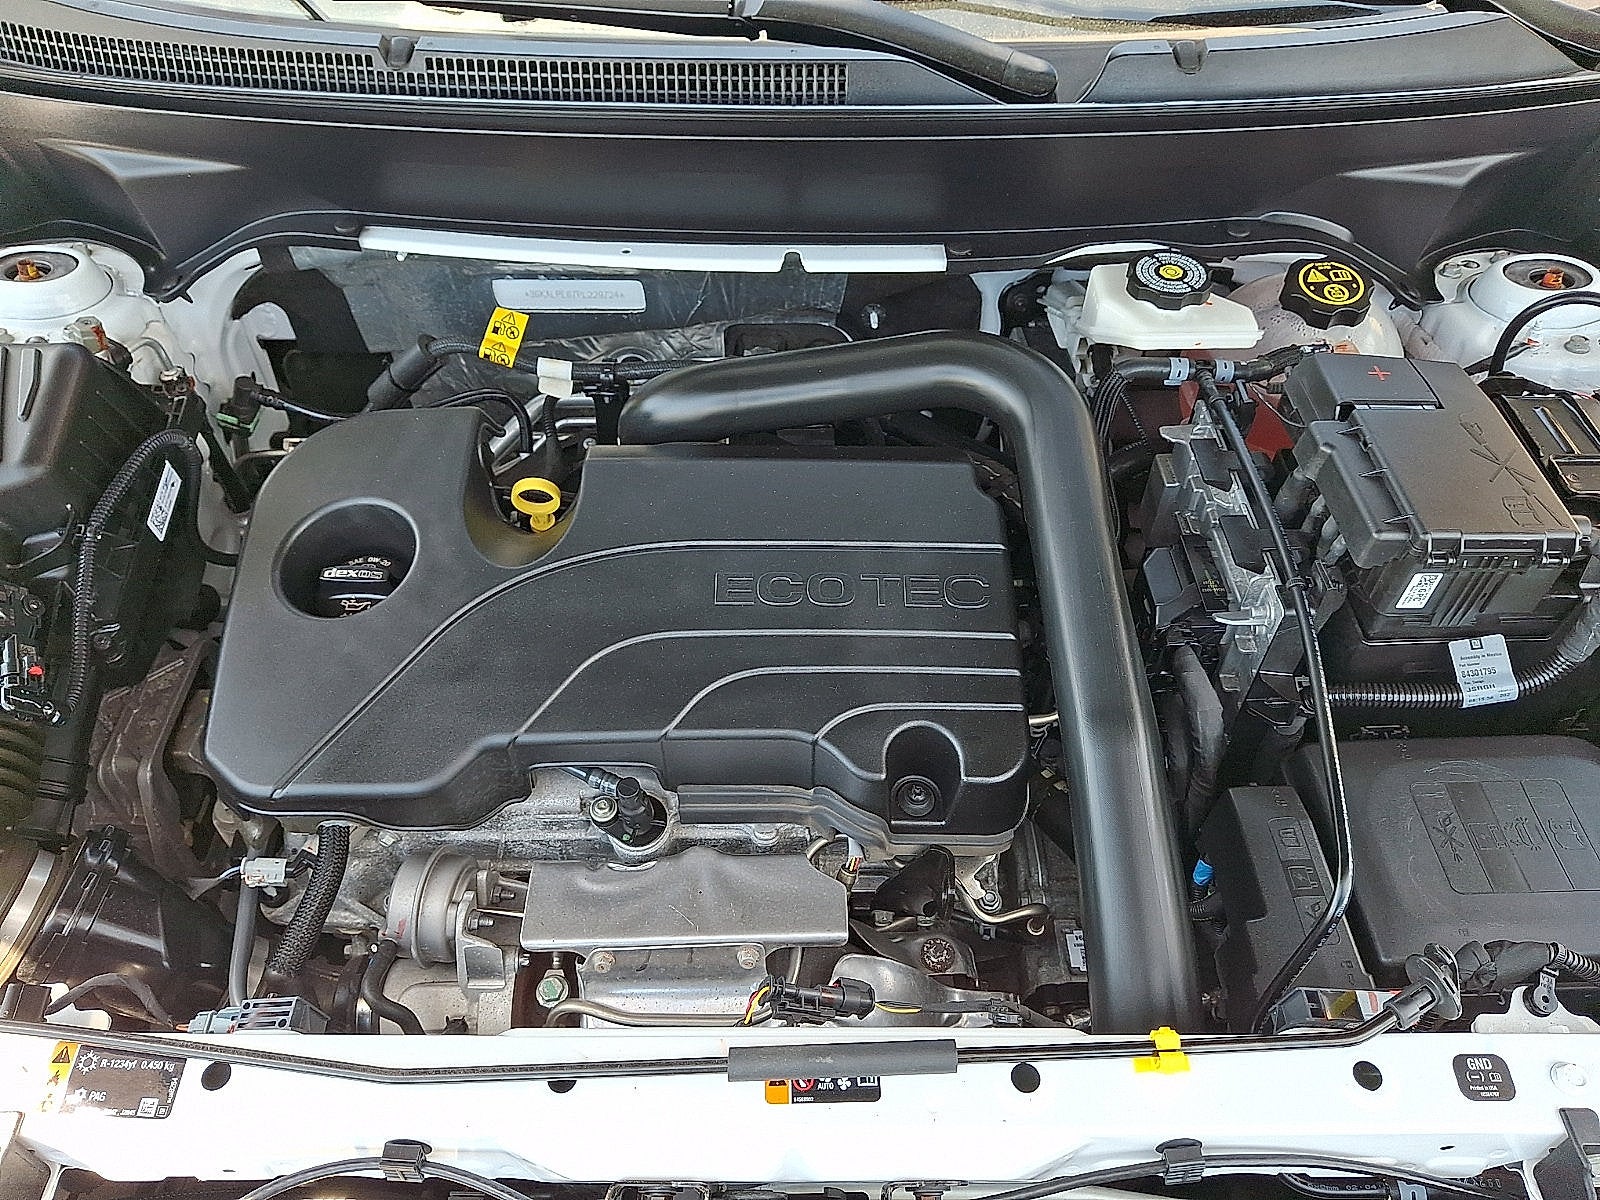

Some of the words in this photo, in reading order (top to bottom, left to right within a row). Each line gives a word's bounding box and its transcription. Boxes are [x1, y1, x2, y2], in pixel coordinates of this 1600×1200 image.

[367, 556, 392, 567] 0W-20
[323, 567, 384, 580] dexos
[714, 571, 991, 610] ECOTEC
[1461, 667, 1497, 678] 84301795
[100, 1058, 137, 1071] R-1234yf
[140, 1059, 164, 1070] 0.450
[164, 1060, 176, 1072] kg
[1466, 1057, 1493, 1070] GND
[817, 1082, 834, 1091] AUTO
